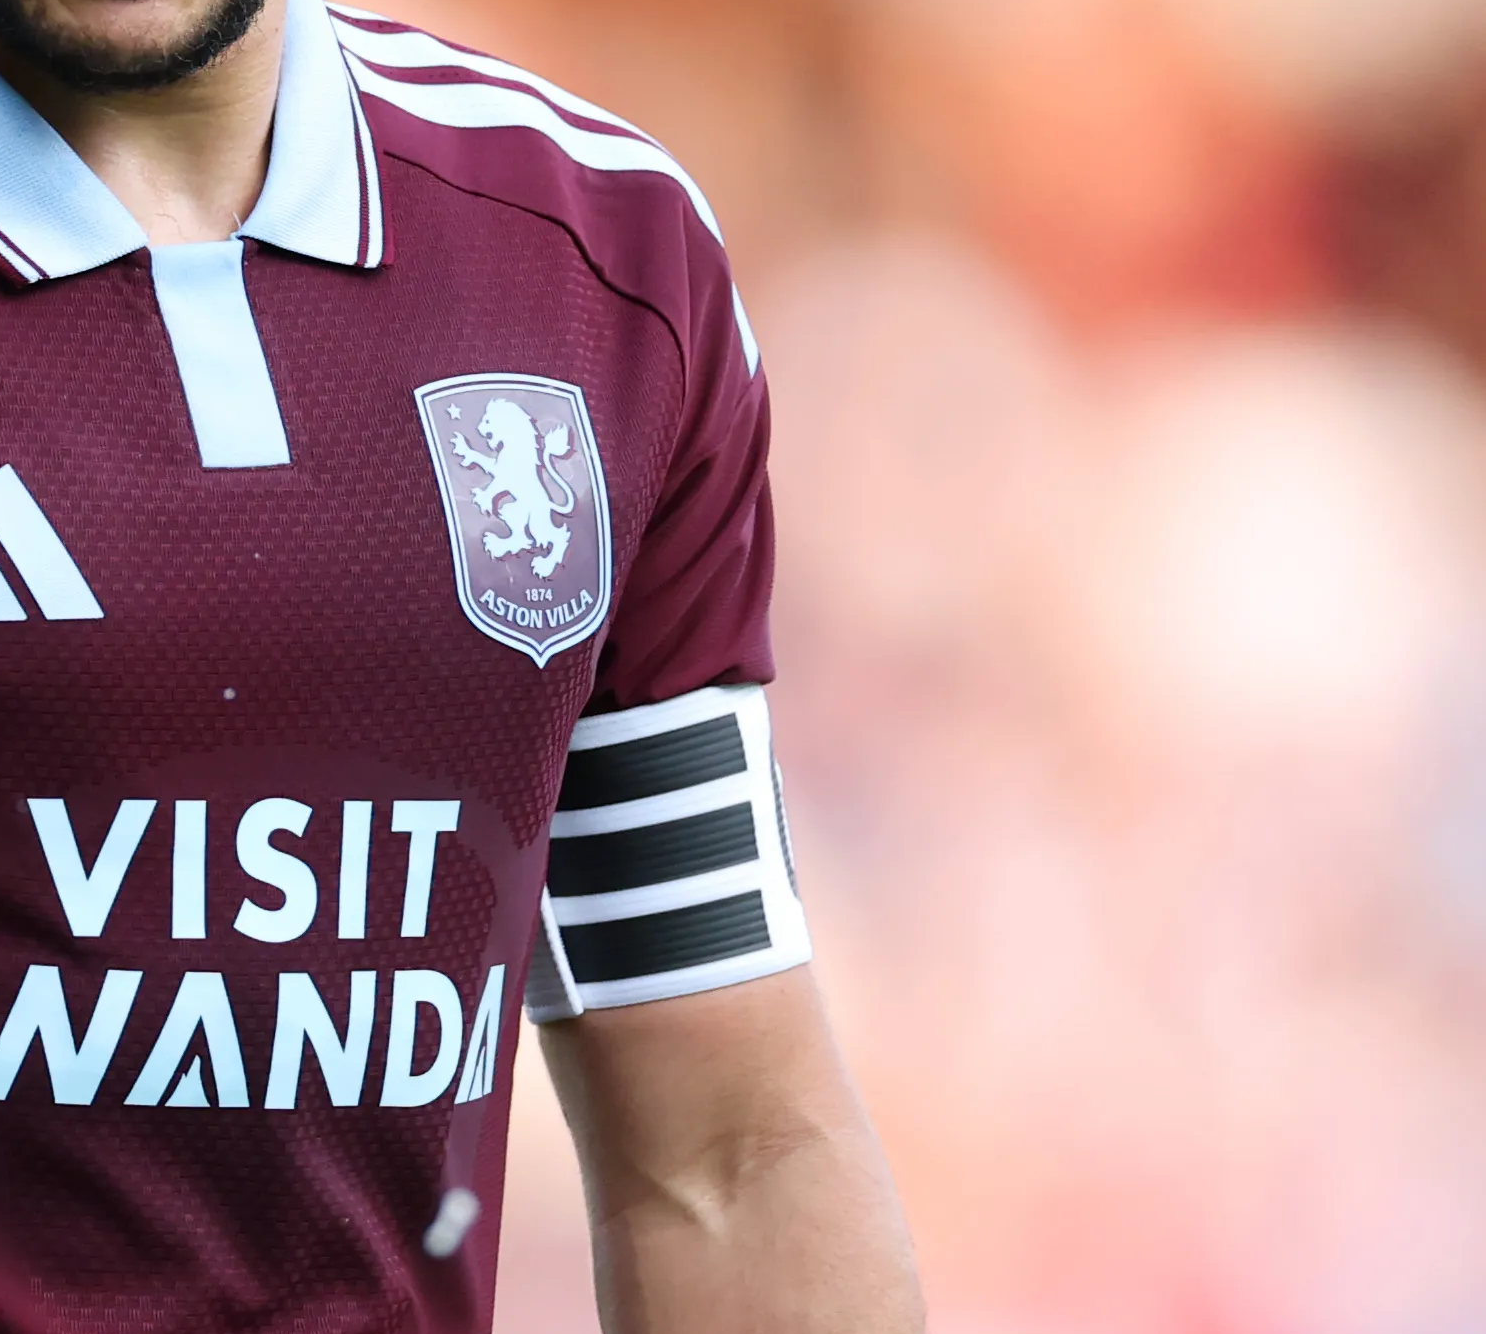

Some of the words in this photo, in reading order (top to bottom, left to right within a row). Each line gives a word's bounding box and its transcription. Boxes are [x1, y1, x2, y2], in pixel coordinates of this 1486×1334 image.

[479, 588, 544, 629] ASTON
[545, 588, 594, 628] VILLA
[525, 588, 553, 602] 1874
[26, 797, 461, 943] VISIT
